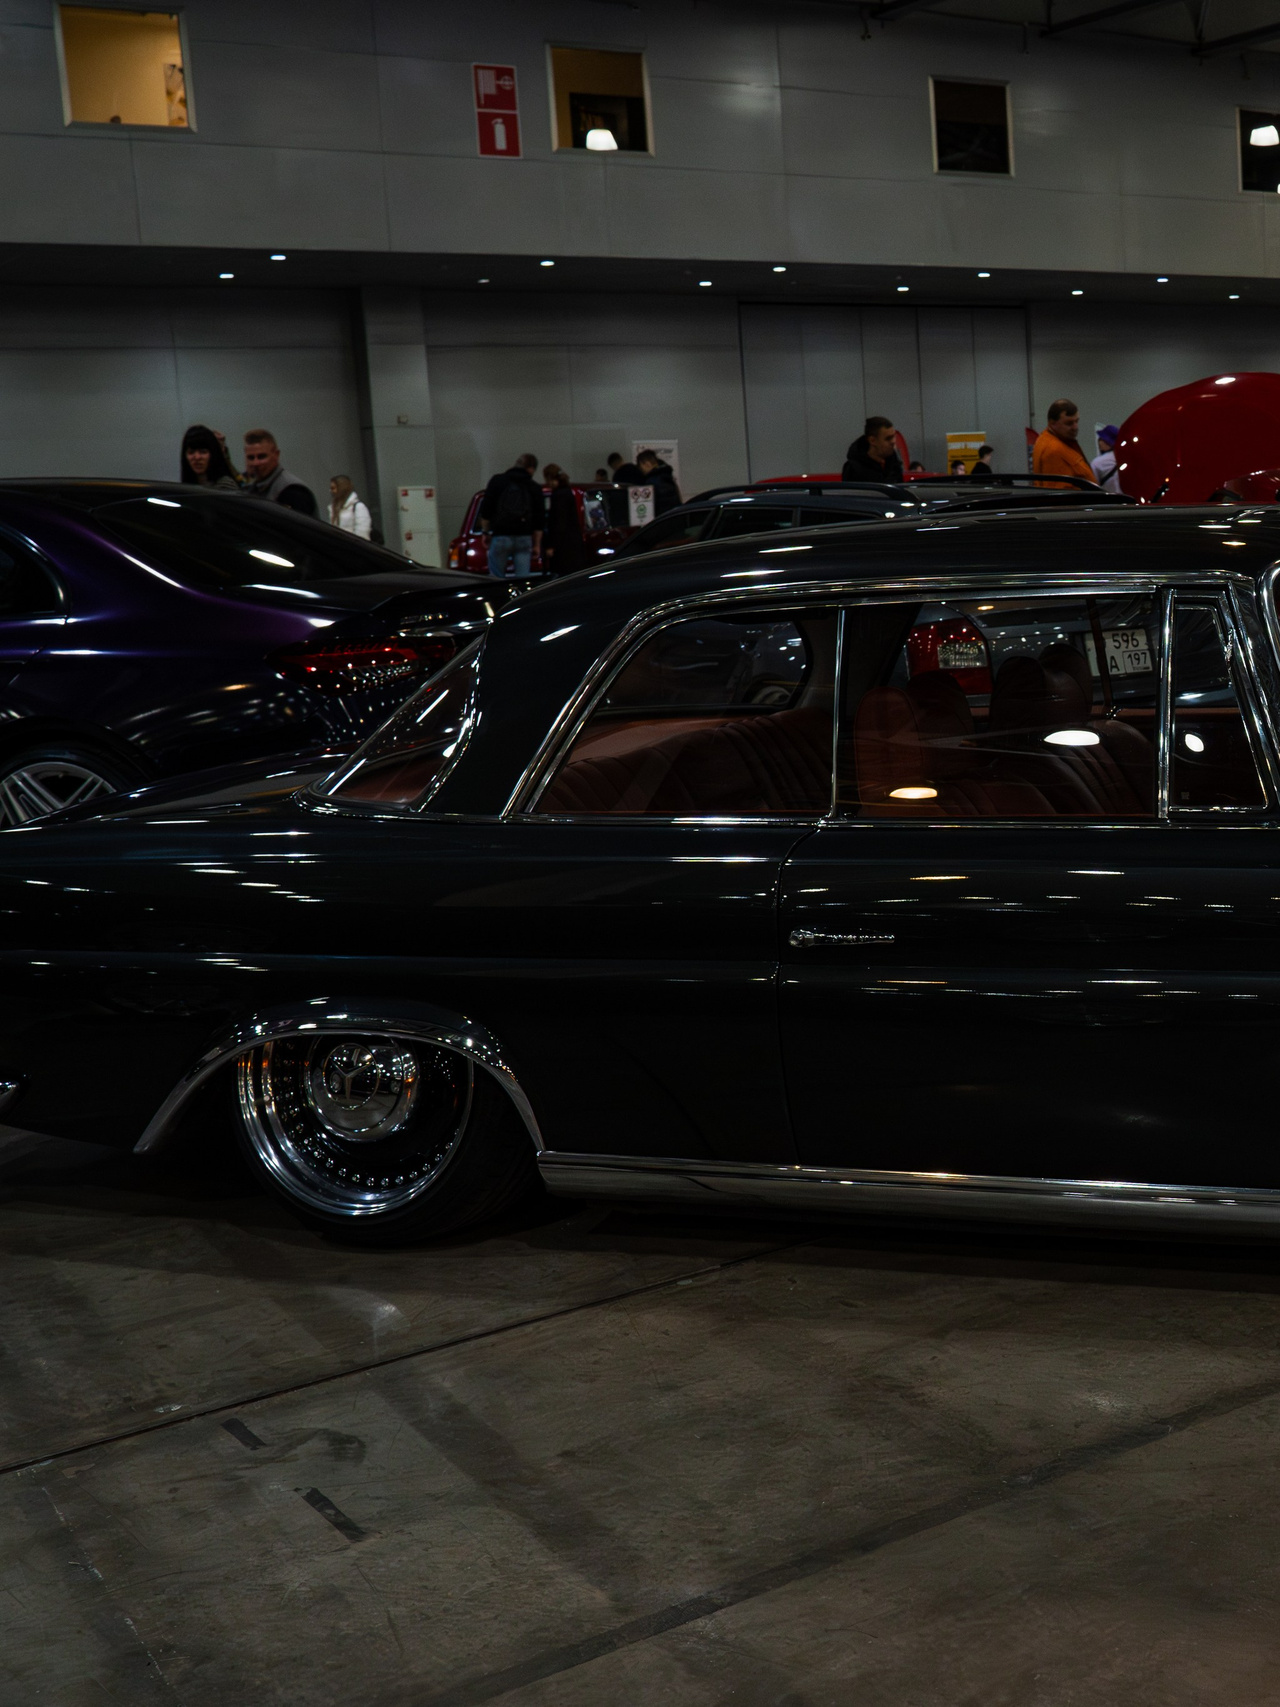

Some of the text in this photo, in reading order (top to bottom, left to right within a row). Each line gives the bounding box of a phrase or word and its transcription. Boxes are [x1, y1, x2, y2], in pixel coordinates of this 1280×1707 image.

[1112, 632, 1139, 649] 596
[1110, 652, 1147, 673] A 197
